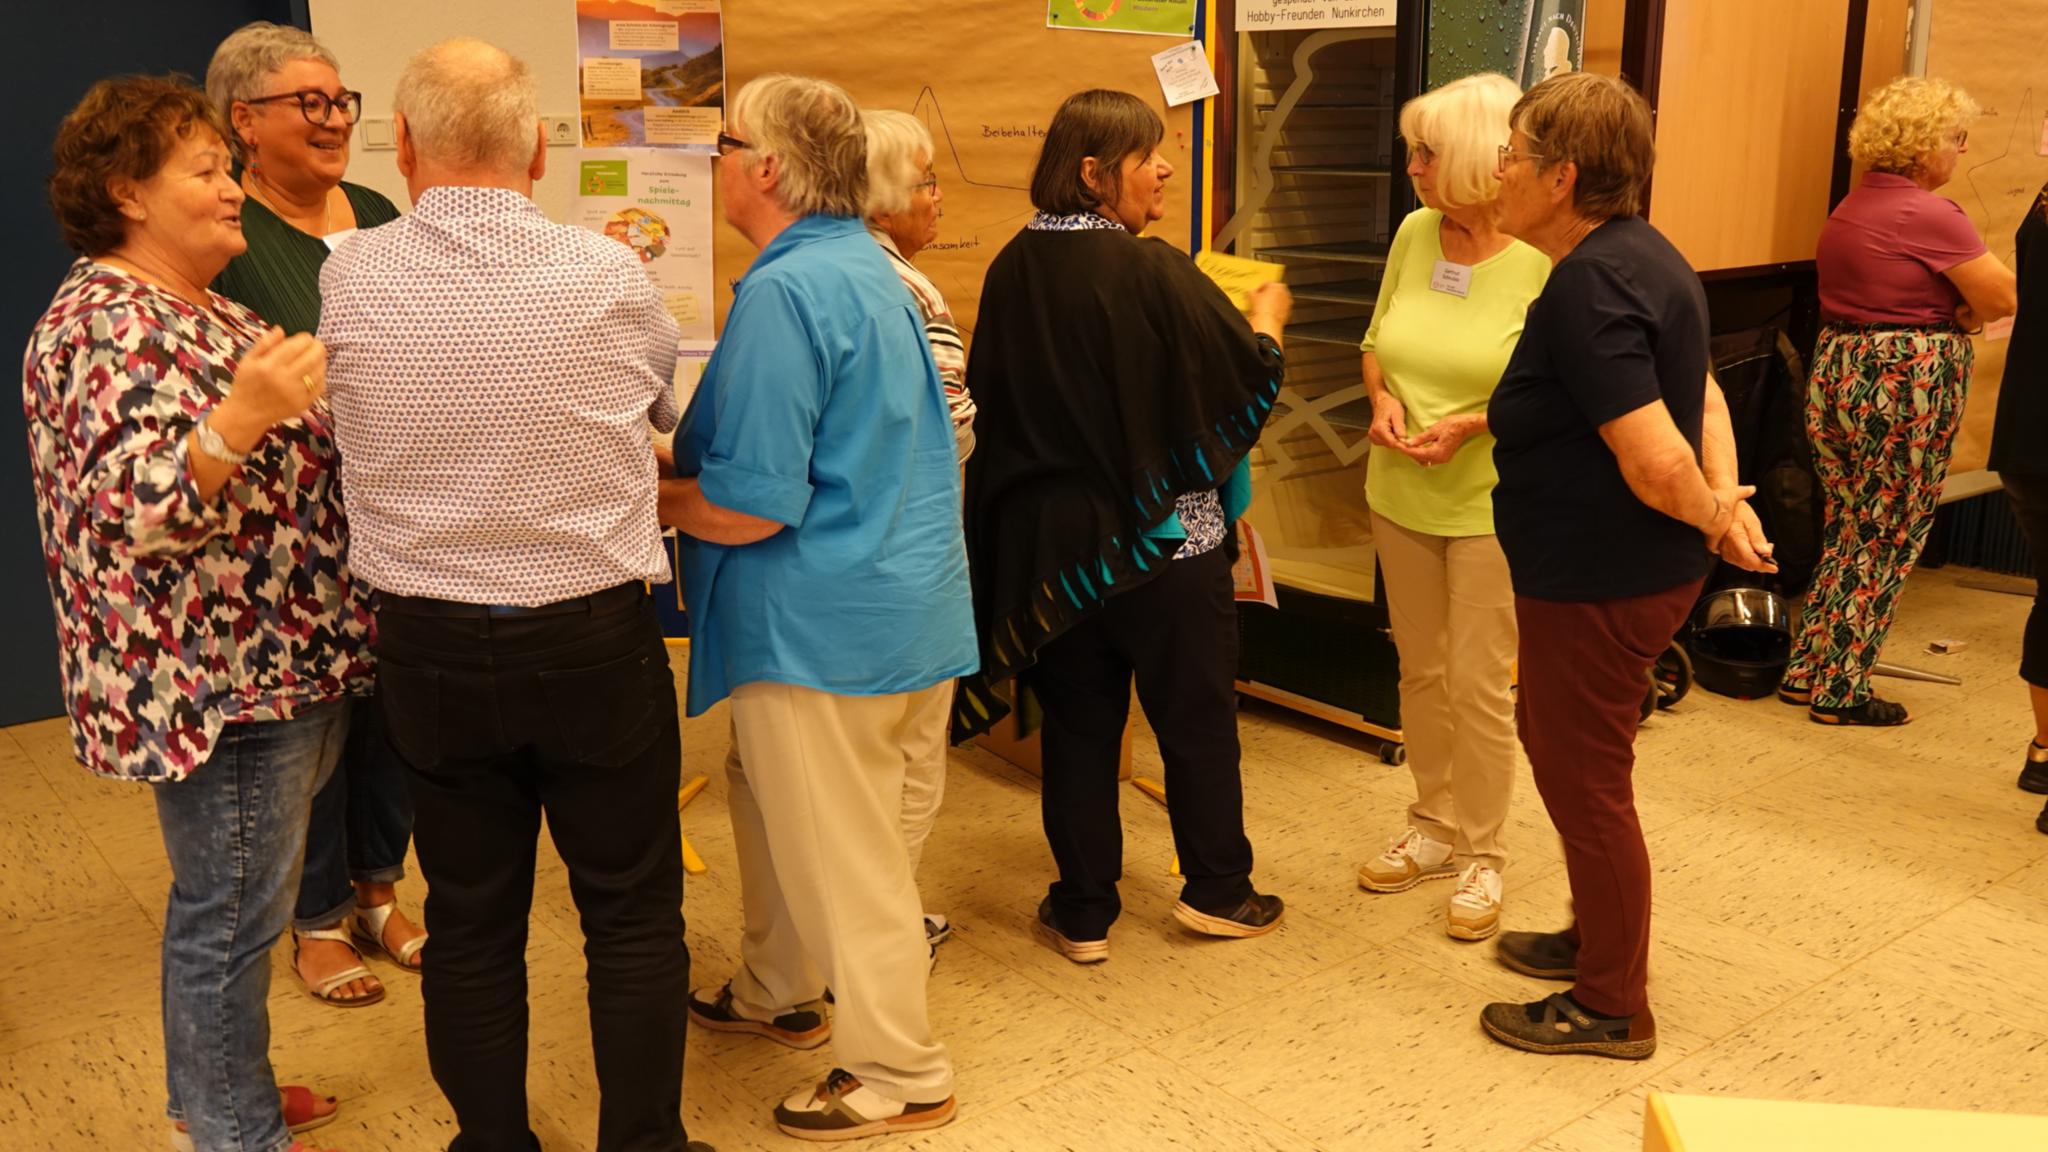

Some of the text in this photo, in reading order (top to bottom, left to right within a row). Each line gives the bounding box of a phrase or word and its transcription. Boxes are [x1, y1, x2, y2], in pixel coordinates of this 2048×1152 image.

[1247, 5, 1385, 24] Hobby-Freunden Nunkirchen
[648, 185, 680, 196] Spiele-
[637, 196, 691, 208] nachmittag
